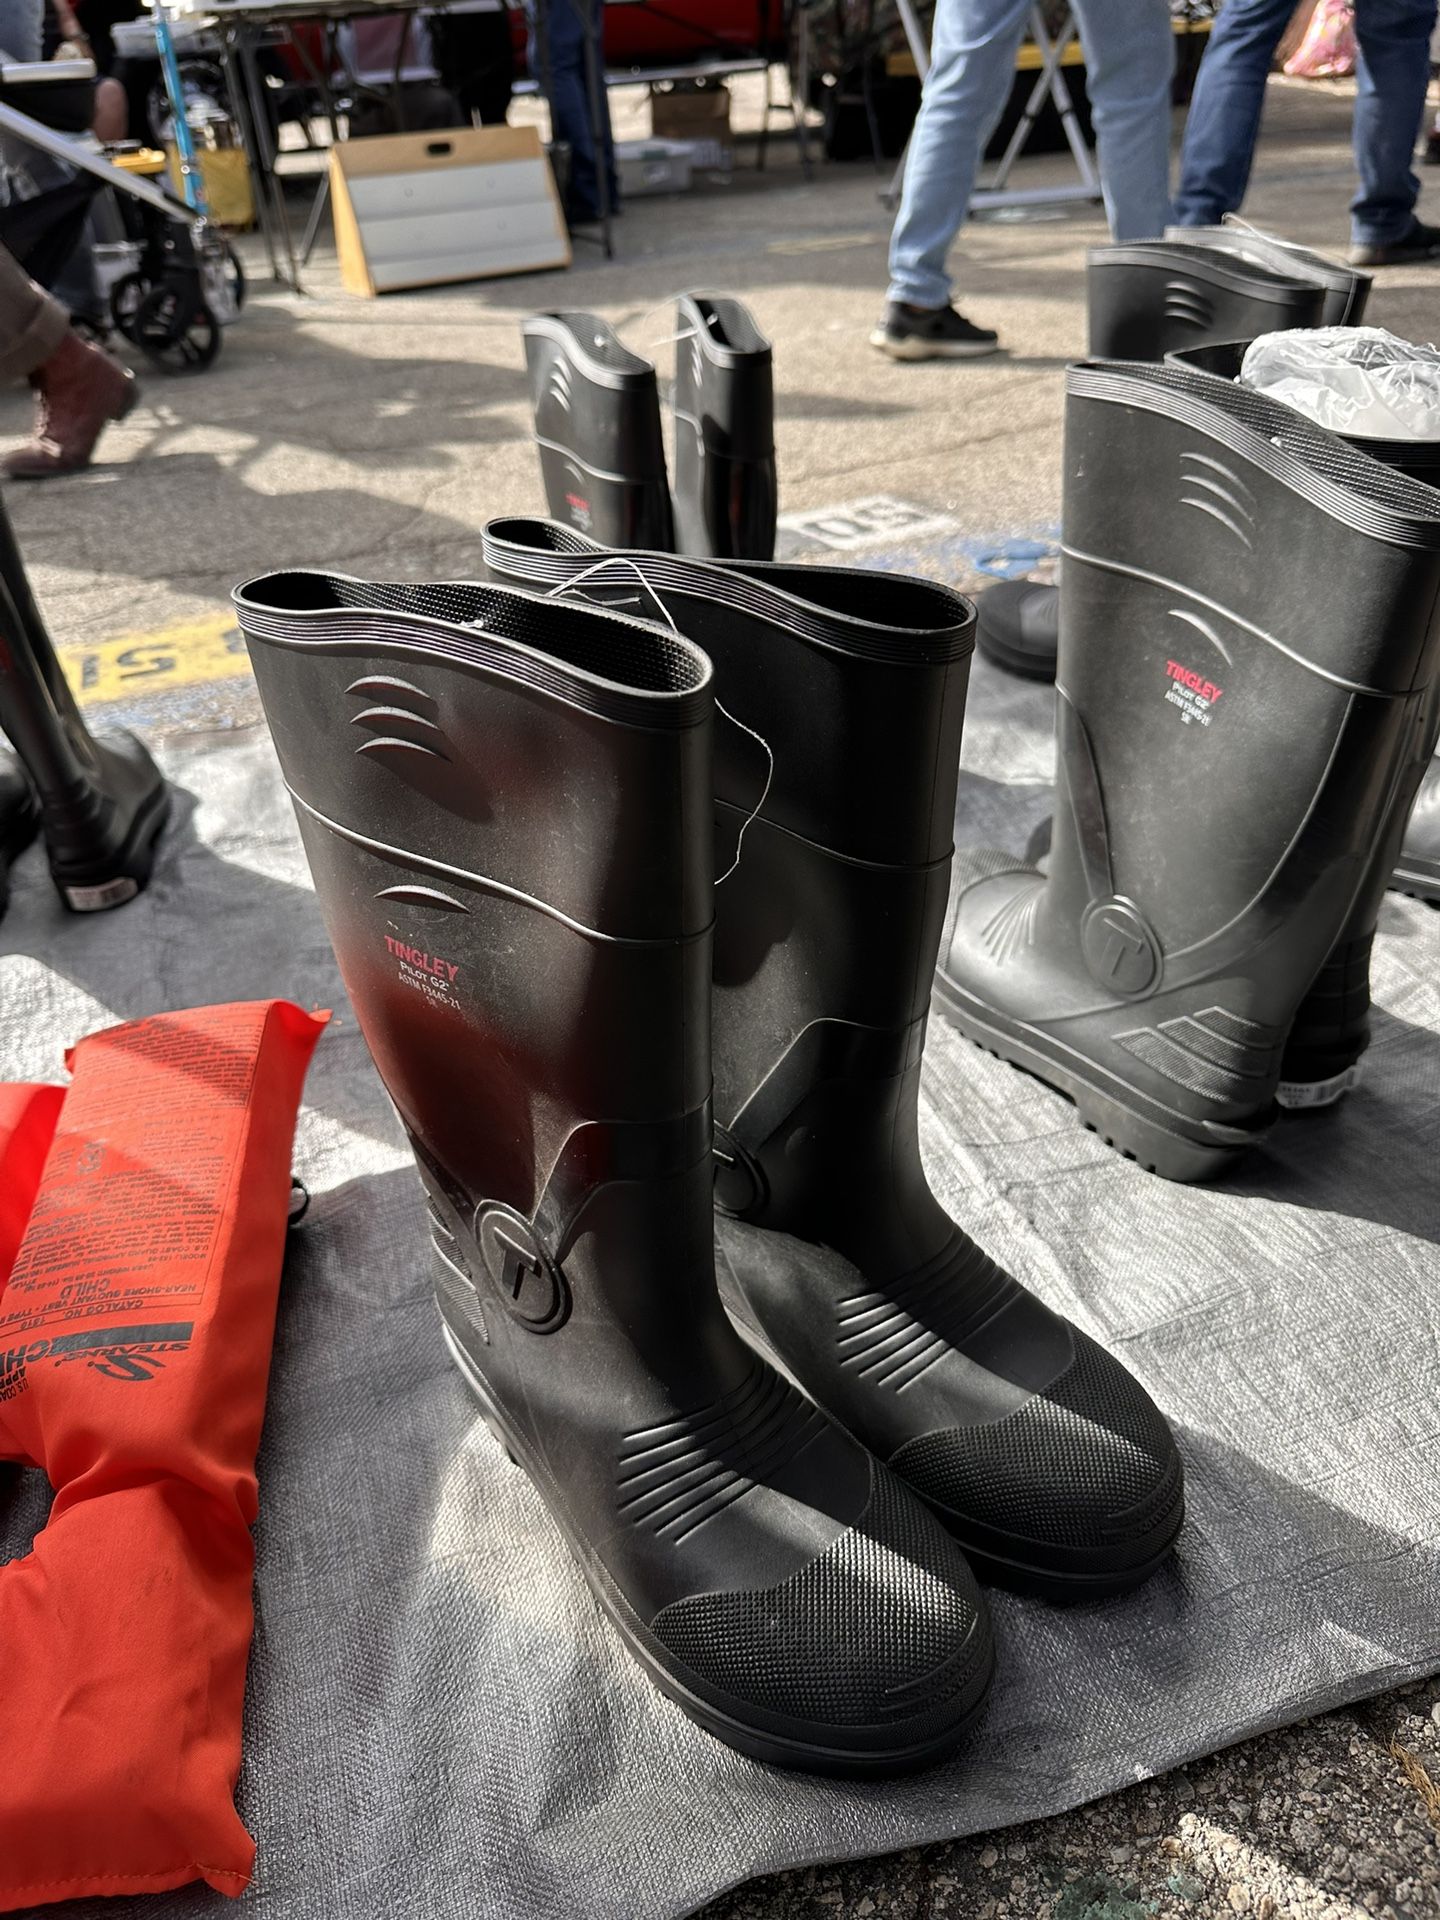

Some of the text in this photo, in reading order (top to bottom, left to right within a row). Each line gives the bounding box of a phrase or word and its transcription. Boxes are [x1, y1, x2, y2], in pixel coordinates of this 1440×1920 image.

[1166, 659, 1223, 704] TINGLEY
[383, 934, 459, 982] TINGLEY
[399, 960, 427, 982] PILOT
[397, 971, 461, 1010] ASTM F3445-21
[59, 1277, 111, 1300] CHILD
[70, 1289, 121, 1305] BUOYANT
[123, 1284, 197, 1298] NEAR-SHORE
[85, 1299, 144, 1316] CATALOG
[16, 1377, 29, 1393] U.S.
